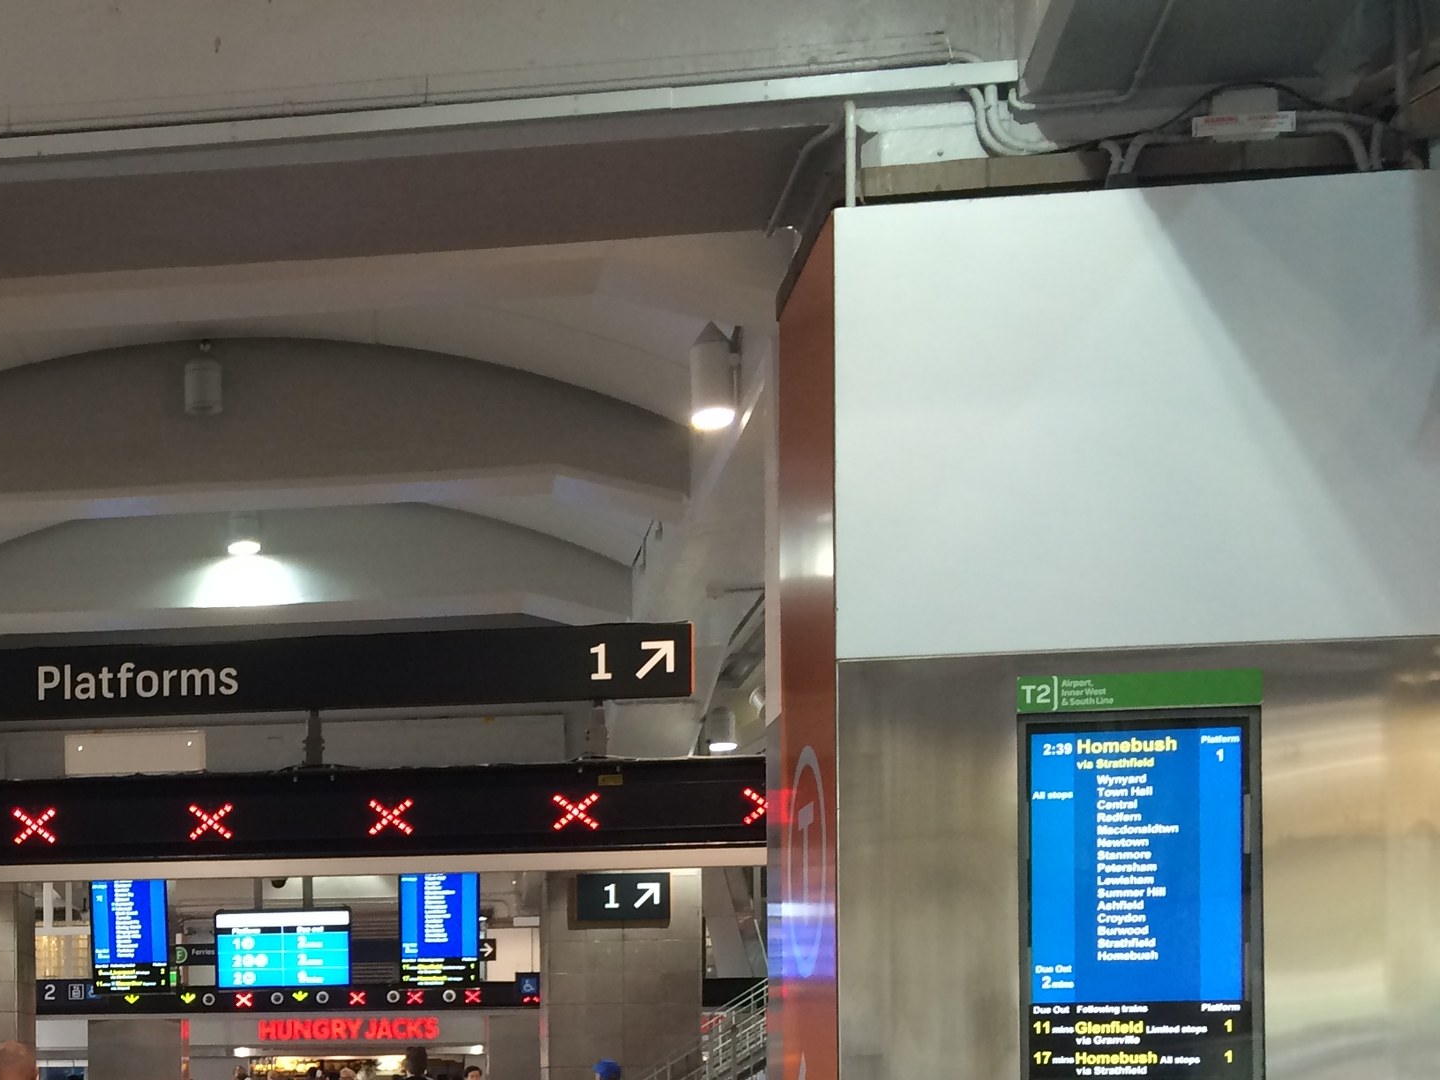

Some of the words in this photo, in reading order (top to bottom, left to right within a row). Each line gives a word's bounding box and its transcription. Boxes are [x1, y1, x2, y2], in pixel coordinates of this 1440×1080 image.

[589, 642, 612, 681] 1
[36, 662, 239, 703] Platforms
[1062, 679, 1093, 688] Airport,
[1021, 684, 1050, 704] T2
[1085, 688, 1106, 696] West
[1070, 697, 1094, 705] South
[1201, 735, 1240, 744] Platform
[1043, 743, 1072, 755] 2:39
[1077, 737, 1177, 754] Homebush
[1216, 749, 1224, 762] 1
[1077, 760, 1093, 769] via
[1097, 758, 1154, 769] Strathfield
[1097, 774, 1147, 786] Wynyard
[1032, 791, 1046, 799] All
[1097, 787, 1128, 797] Town
[1131, 786, 1153, 797] Hall
[1097, 800, 1138, 810] Central
[1097, 812, 1142, 822] Redfern
[1097, 838, 1149, 847] Newtown
[1097, 850, 1151, 860] Stanmore
[1097, 862, 1157, 873] Petersham
[1097, 875, 1154, 886] Lewisham
[604, 884, 620, 908] 1
[1097, 888, 1145, 899] Summer
[1147, 886, 1166, 897] Hill
[1097, 900, 1144, 910] Ashfield
[1097, 913, 1146, 924] Croydon
[1097, 925, 1149, 936] Burwood
[1097, 938, 1156, 949] Strathfield
[1097, 951, 1158, 961] Homebush
[1042, 976, 1051, 989] 2
[45, 984, 55, 1000] 2
[1033, 1006, 1051, 1014] Due
[1053, 1006, 1070, 1014] Out
[1201, 1003, 1240, 1012] Platform
[258, 1018, 364, 1040] HUNGRY
[1034, 1021, 1050, 1034] 11
[1075, 1021, 1143, 1034] Glenfield
[1224, 1019, 1232, 1032] 1
[1076, 1036, 1092, 1045] via
[1094, 1036, 1140, 1045] Granville
[1034, 1052, 1052, 1064] 17
[1075, 1051, 1158, 1065] Homebush
[1160, 1056, 1172, 1064] All
[1224, 1050, 1232, 1063] 1
[1076, 1067, 1092, 1076] via
[1094, 1066, 1147, 1075] Strathfield
